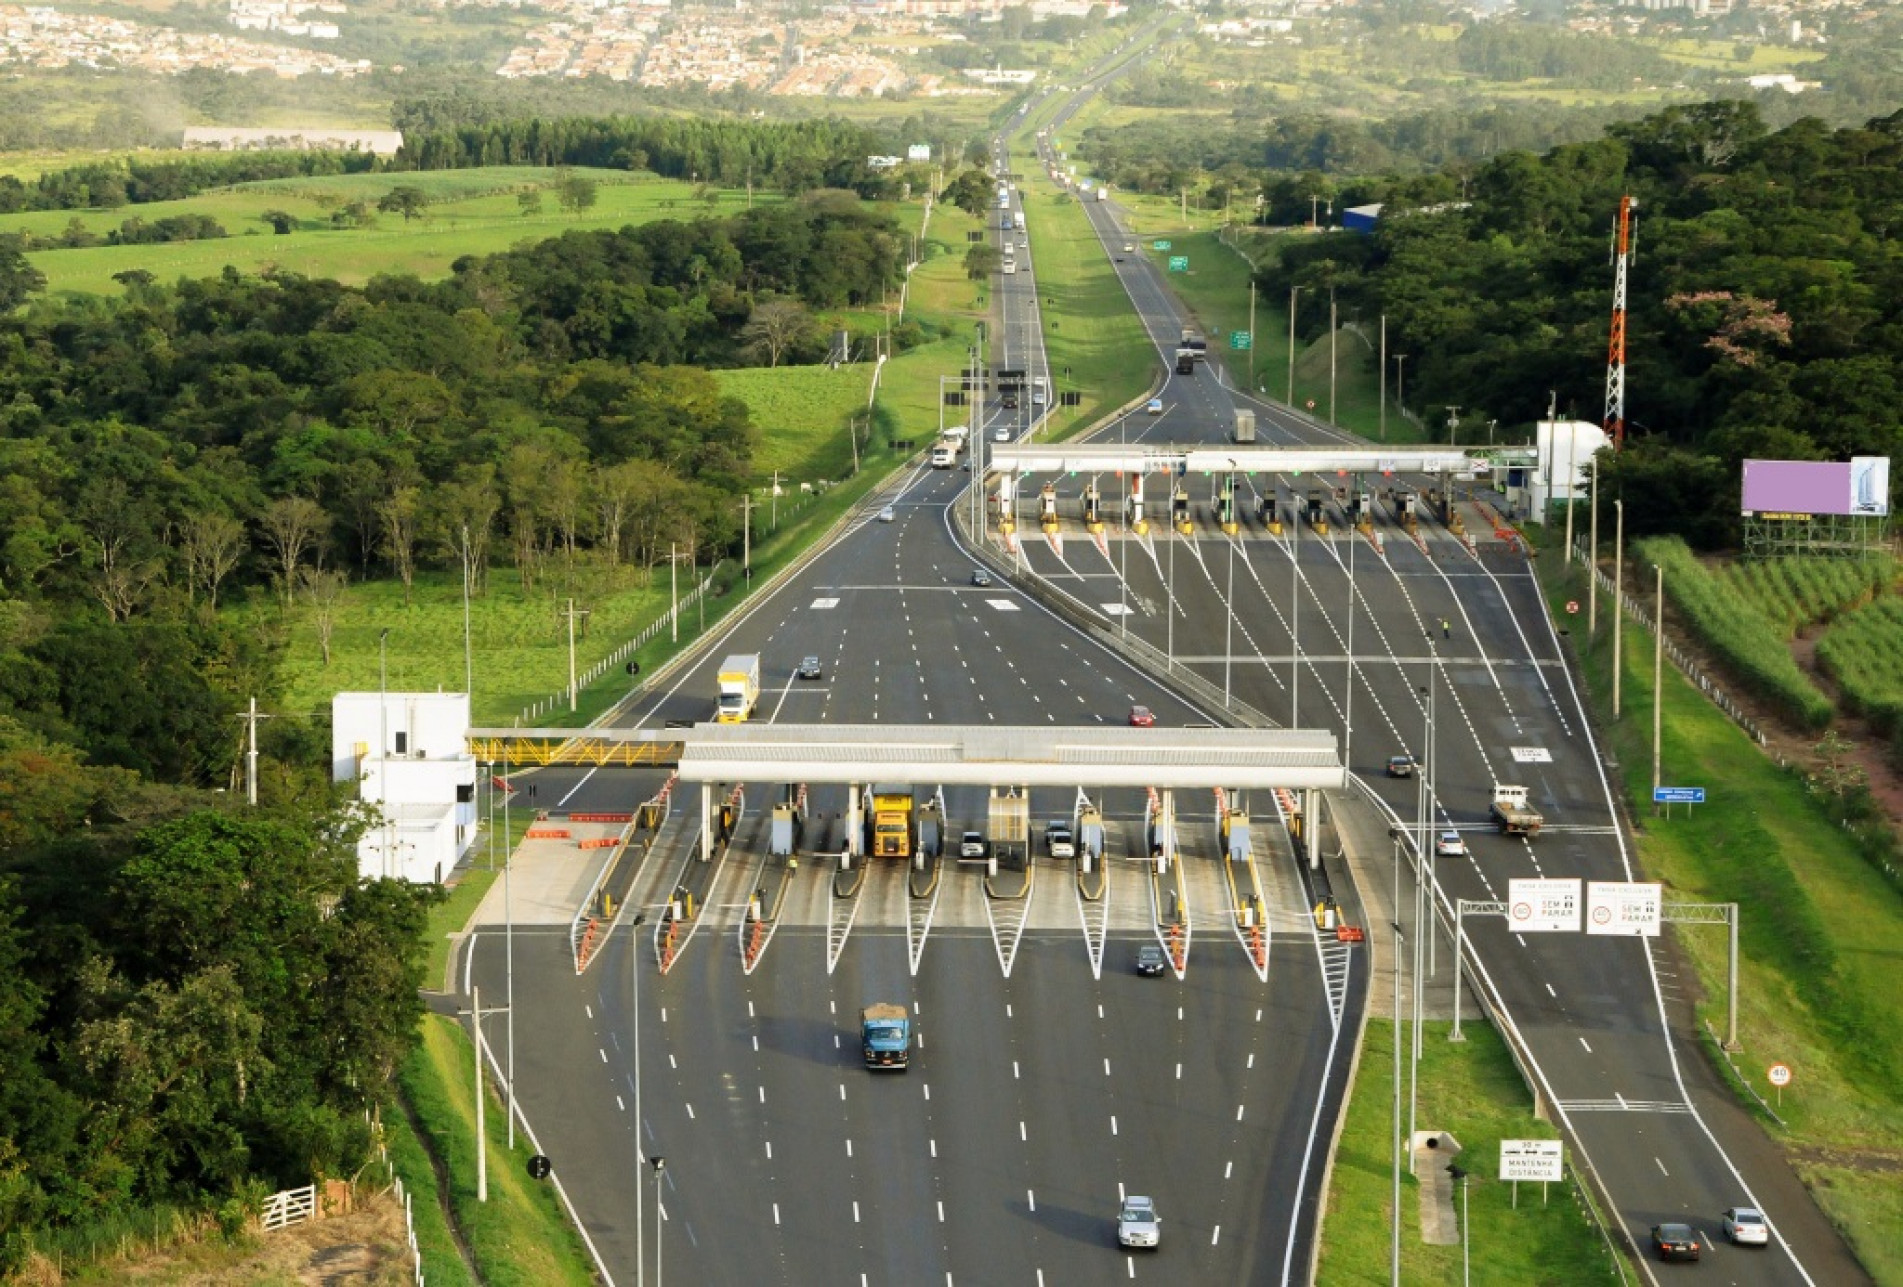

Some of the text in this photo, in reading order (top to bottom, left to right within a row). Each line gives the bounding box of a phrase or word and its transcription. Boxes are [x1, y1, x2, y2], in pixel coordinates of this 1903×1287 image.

[1542, 900, 1560, 909] SEM
[1622, 904, 1642, 913] SEM
[1542, 909, 1573, 917] PARAR
[1773, 1068, 1786, 1077] 40
